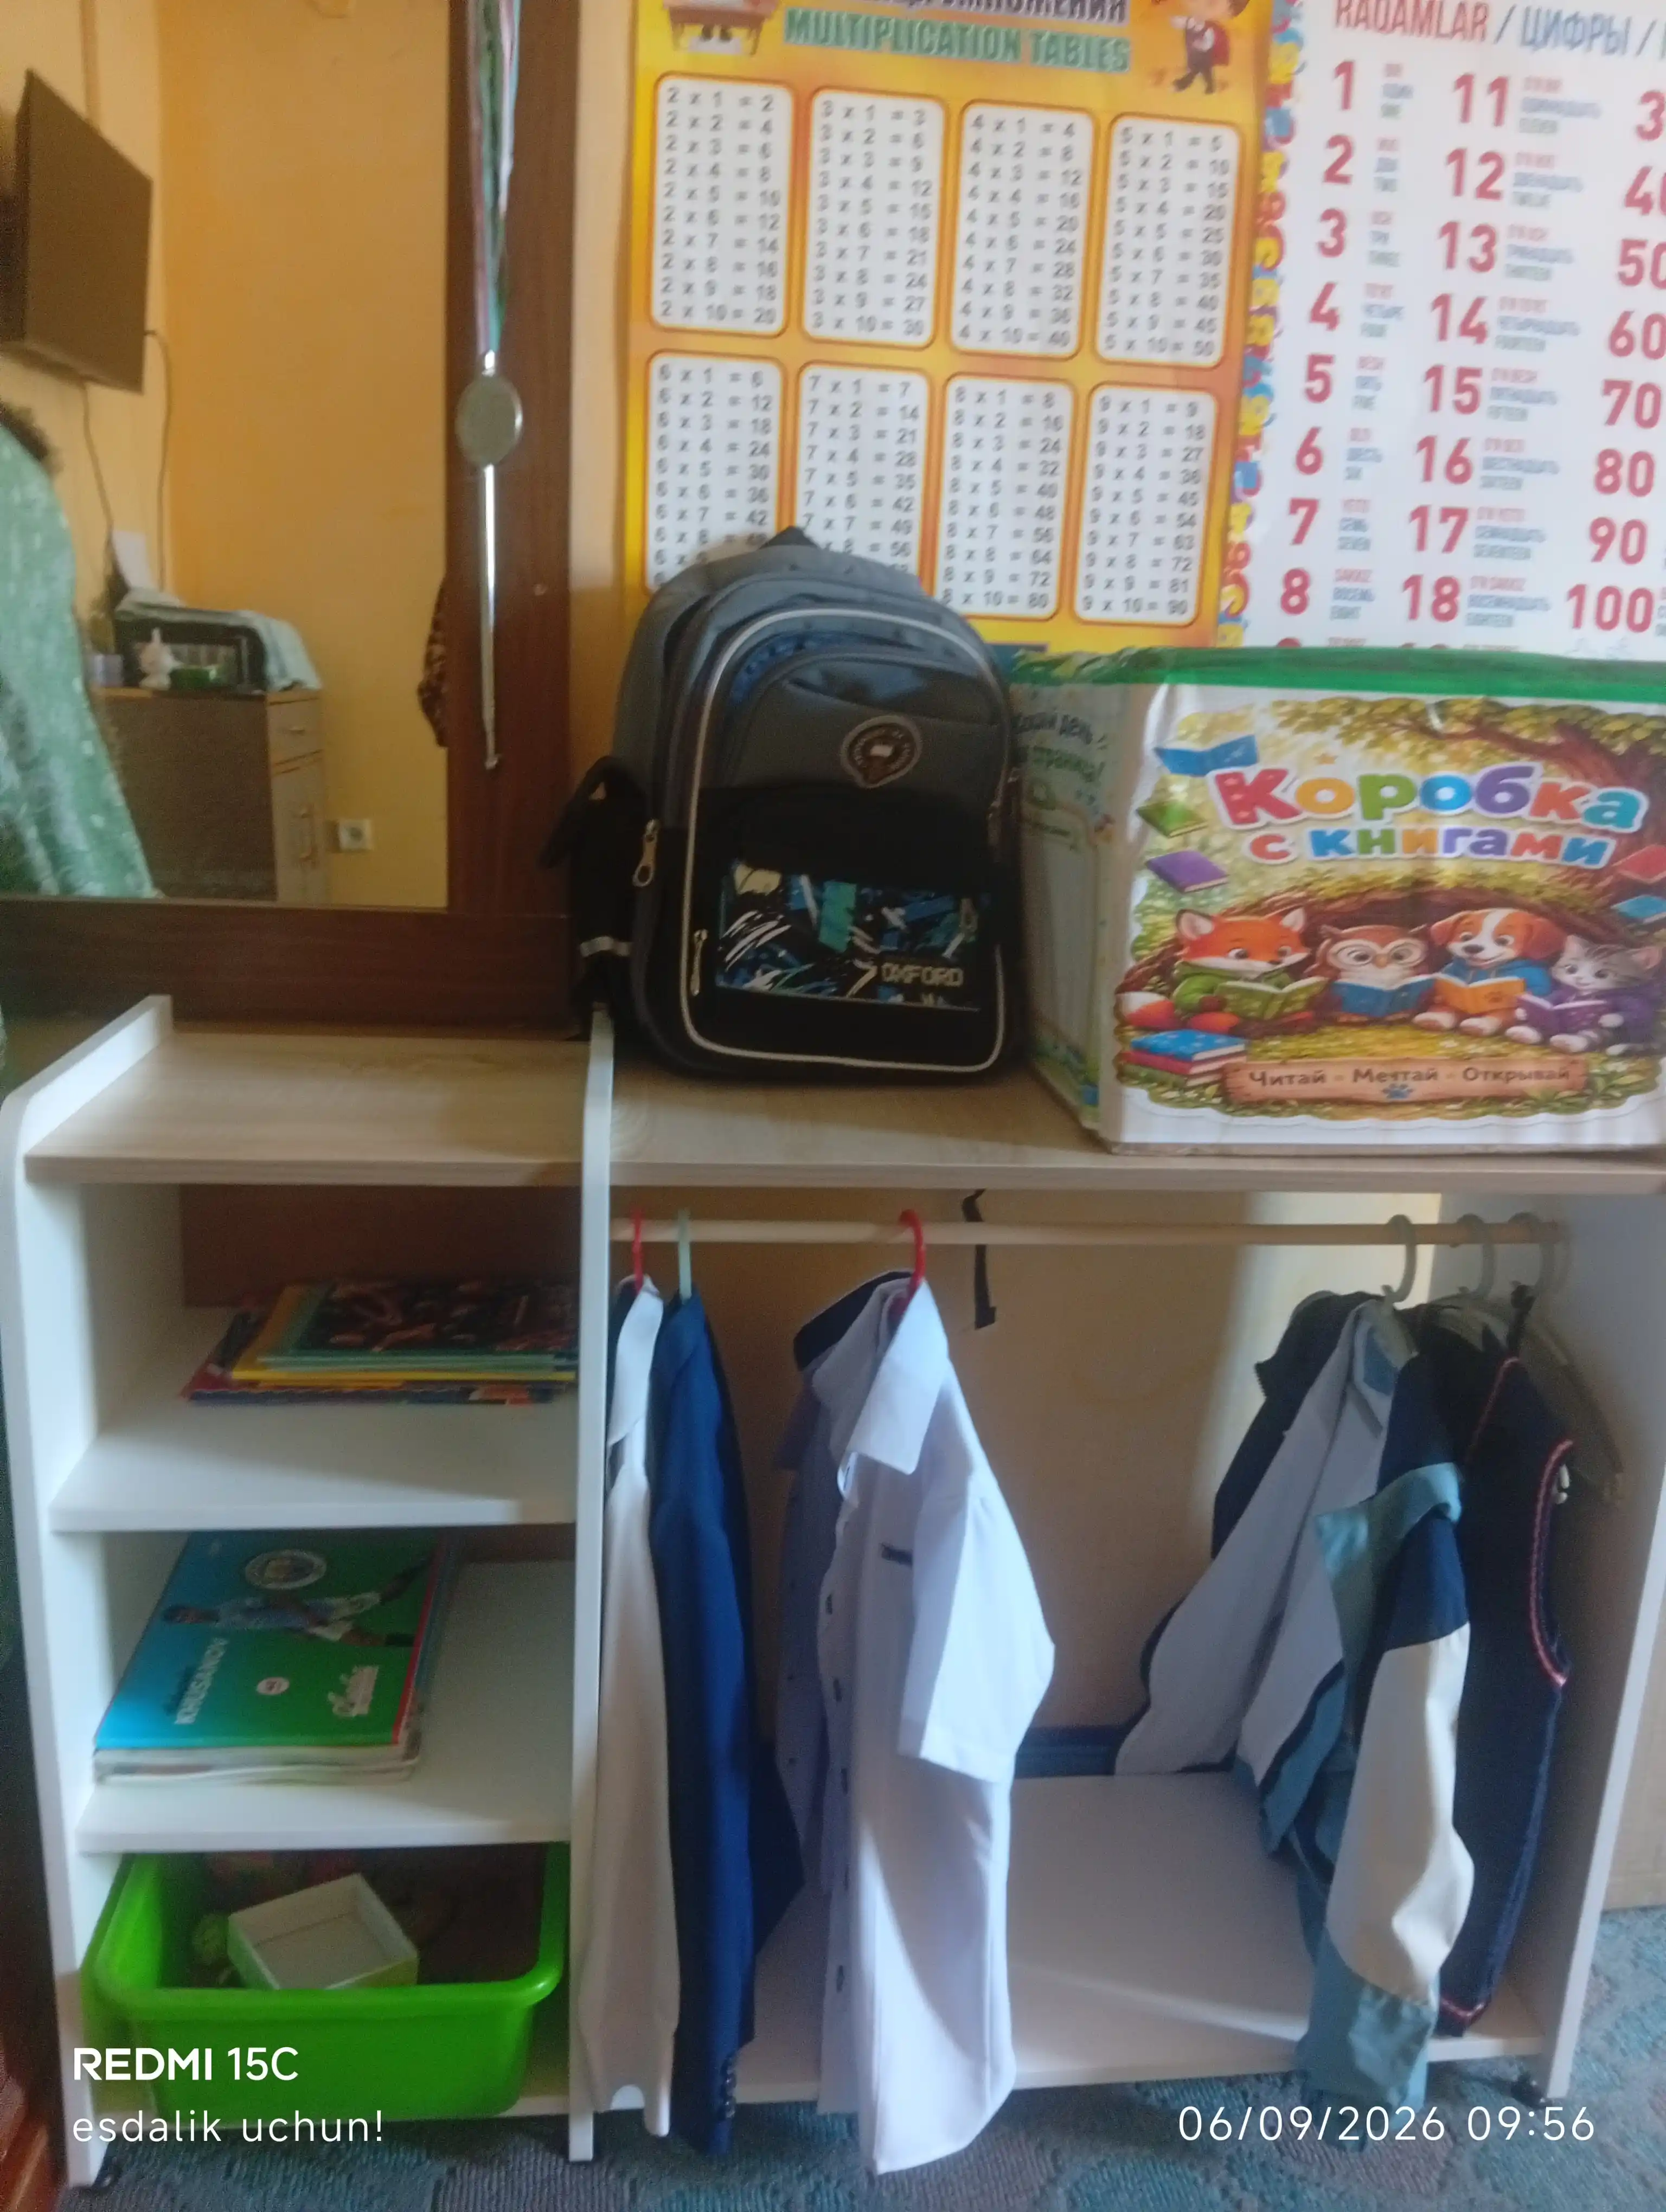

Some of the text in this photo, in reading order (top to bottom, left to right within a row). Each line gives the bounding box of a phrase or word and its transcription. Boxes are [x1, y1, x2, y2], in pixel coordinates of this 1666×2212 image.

[786, 8, 1130, 72] MULTIPLICATION TABLES
[1520, 5, 1632, 55] ЦИФРЫ
[667, 87, 679, 104] 2
[713, 91, 721, 107] 1
[761, 94, 773, 112] 2
[1335, 61, 1354, 110] 1
[1456, 74, 1508, 125] 11
[665, 110, 677, 128] 2
[710, 114, 723, 132] 2
[760, 119, 772, 135] 4
[972, 114, 984, 130] 4
[1017, 117, 1025, 133] 1
[1063, 123, 1075, 138] 4
[1122, 127, 1132, 144] 5
[1164, 131, 1172, 145] 1
[1211, 136, 1221, 152] 5
[1324, 135, 1353, 184] 2
[1447, 149, 1504, 201] 12
[861, 175, 873, 190] 4
[912, 180, 932, 197] 12
[1625, 168, 1666, 215] 4
[662, 228, 674, 246] 2
[708, 233, 718, 248] 7
[758, 237, 779, 253] 14
[1114, 220, 1124, 236] 5
[1156, 223, 1166, 240] 5
[1202, 227, 1224, 244] 25
[1320, 209, 1346, 258] 3
[1441, 222, 1496, 272] 13
[859, 245, 870, 261] 7
[907, 249, 926, 266] 21
[963, 255, 975, 270] 4
[1007, 258, 1016, 273] 7
[1620, 240, 1666, 290] 50
[1310, 283, 1339, 330] 4
[1433, 294, 1487, 344] 14
[1610, 312, 1666, 359] 60
[701, 391, 713, 408] 2
[752, 395, 772, 411] 12
[809, 375, 821, 390] 7
[853, 378, 861, 394] 1
[901, 382, 911, 396] 7
[997, 389, 1006, 403] 1
[1306, 354, 1333, 403] 5
[1426, 365, 1482, 415] 15
[809, 398, 819, 414] 7
[850, 401, 862, 418] 2
[899, 405, 919, 421] 14
[1604, 380, 1661, 428] 70
[807, 445, 818, 460] 7
[847, 448, 859, 464] 4
[1181, 446, 1204, 462] 27
[1296, 427, 1323, 475] 6
[1418, 436, 1472, 484] 16
[1595, 449, 1655, 497] 80
[699, 506, 709, 522] 7
[746, 510, 767, 526] 42
[805, 490, 815, 506] 7
[892, 497, 913, 513] 42
[1289, 498, 1319, 544] 7
[1411, 506, 1469, 552] 17
[1590, 518, 1646, 565] 90
[1030, 570, 1050, 587] 72
[1172, 556, 1192, 573] 72
[1280, 569, 1310, 615] 8
[1404, 575, 1460, 622] 18
[1568, 584, 1654, 633] 100
[1214, 765, 1641, 829] Коробка
[1309, 826, 1611, 865] книгами
[881, 962, 964, 987] OXFORD
[1249, 1065, 1570, 1086] Читай Мечтай Открывай
